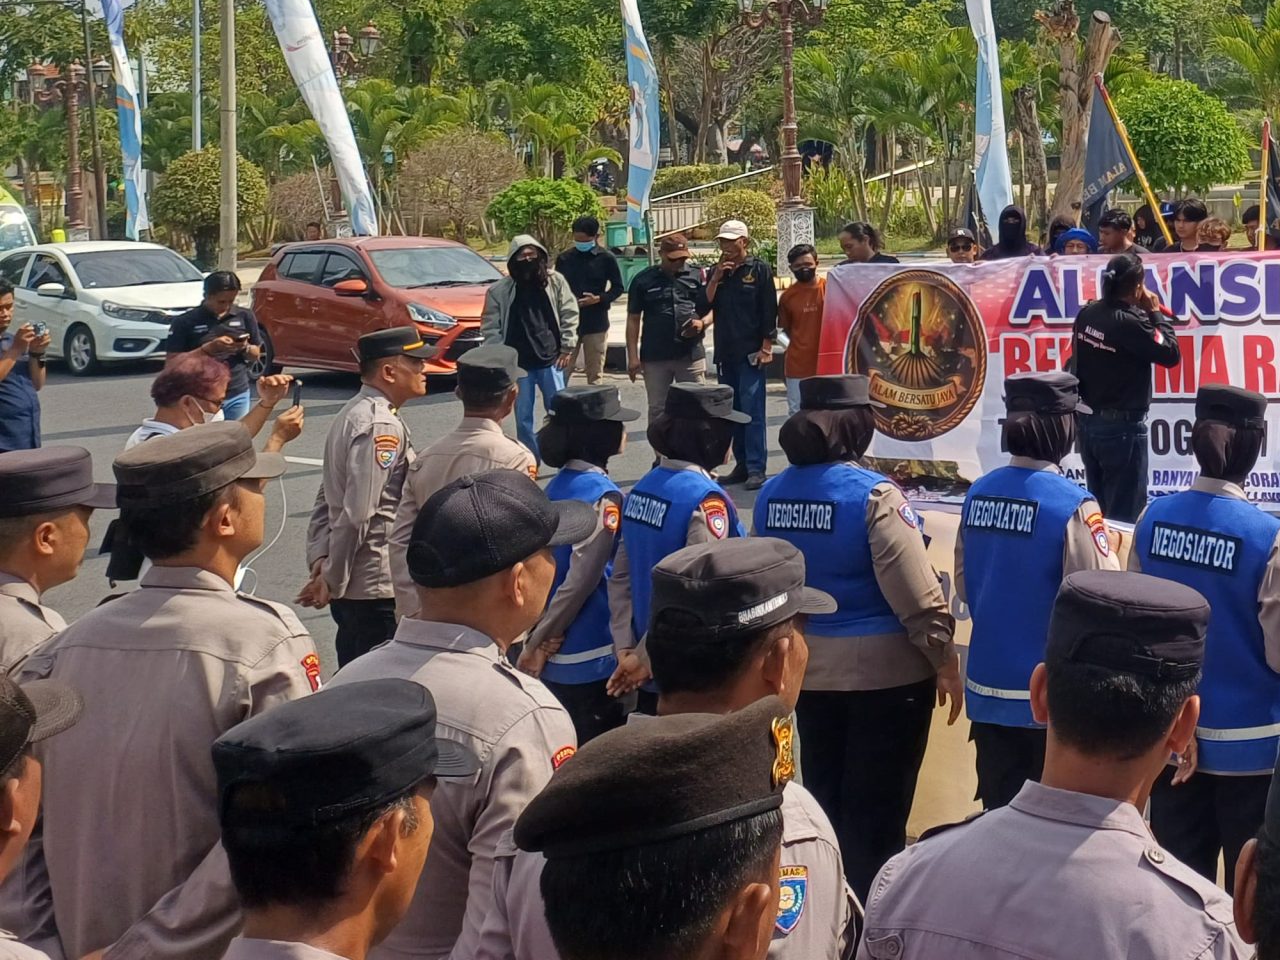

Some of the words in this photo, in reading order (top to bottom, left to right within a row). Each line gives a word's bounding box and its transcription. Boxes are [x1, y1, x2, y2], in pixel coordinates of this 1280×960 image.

[872, 383, 898, 402] ALAM
[899, 391, 936, 406] BERSATU
[936, 388, 955, 406] JAYA
[1152, 469, 1198, 487] BANYA
[766, 502, 832, 531] NEGOSIATOR
[1151, 525, 1236, 571] NEGOSIATOR
